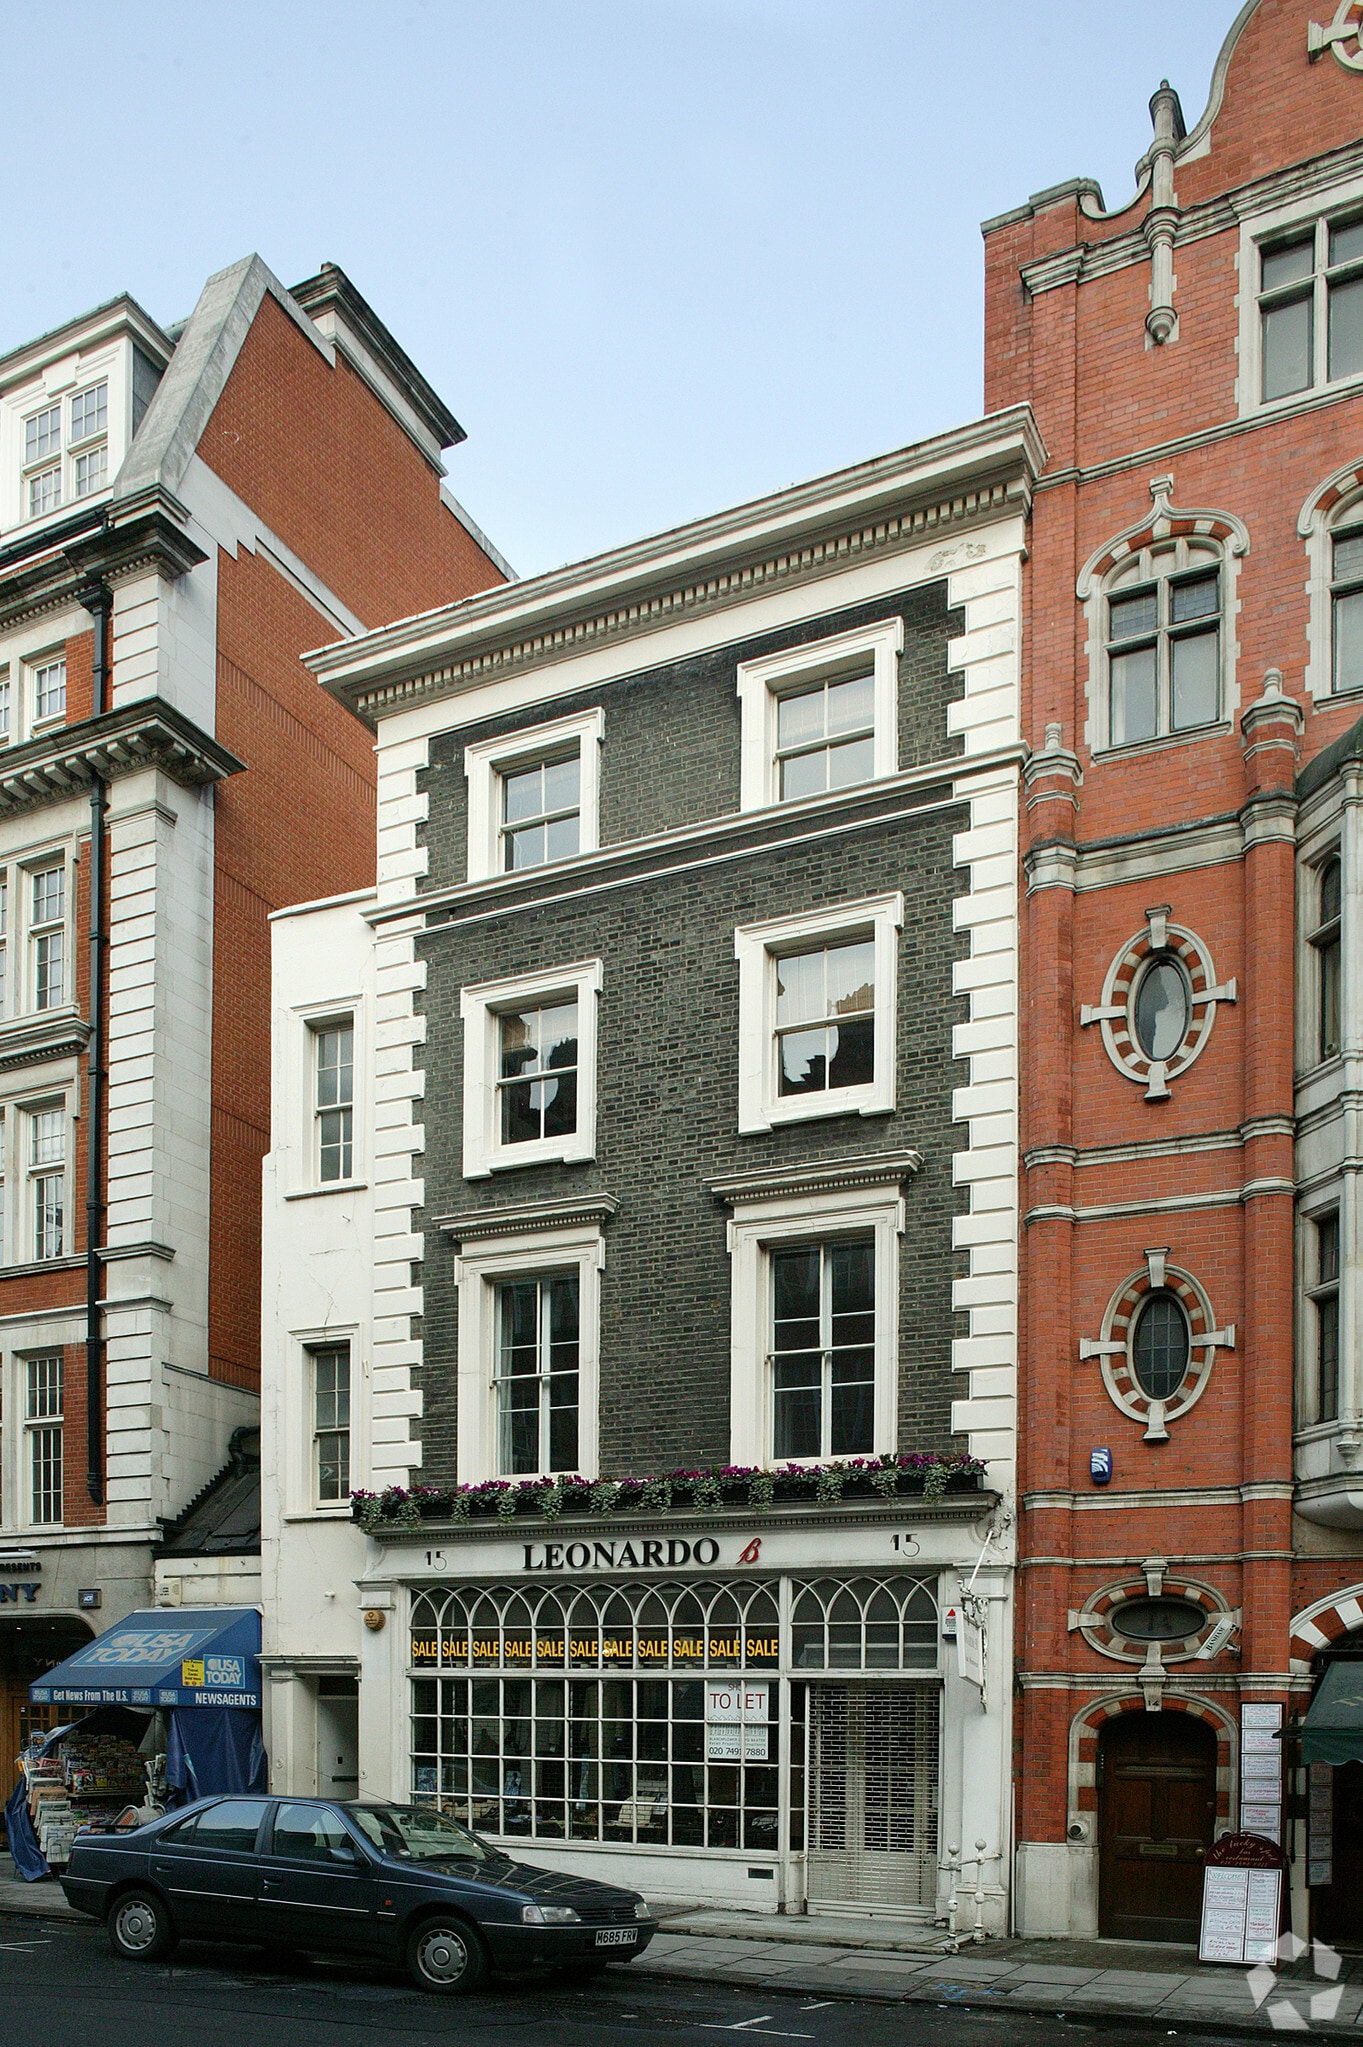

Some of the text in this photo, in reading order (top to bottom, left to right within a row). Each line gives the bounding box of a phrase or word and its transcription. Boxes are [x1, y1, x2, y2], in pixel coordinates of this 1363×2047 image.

[890, 1534, 920, 1557] 15
[424, 1551, 447, 1571] 15
[523, 1538, 720, 1570] LEONARDO
[133, 1633, 194, 1648] USA
[85, 1648, 186, 1663] TODAY
[412, 1640, 778, 1657] SALE SALE SALE SALE SALE SALE SALE SALE SALE SALE SALE
[218, 1659, 240, 1672] USA
[206, 1671, 242, 1685] TODAY
[53, 1690, 129, 1702] Get News From The U.S.
[195, 1692, 257, 1706] NEWSAGENTS
[709, 1693, 766, 1709] TO LET
[709, 1746, 723, 1755] 020
[745, 1748, 766, 1757] 7880
